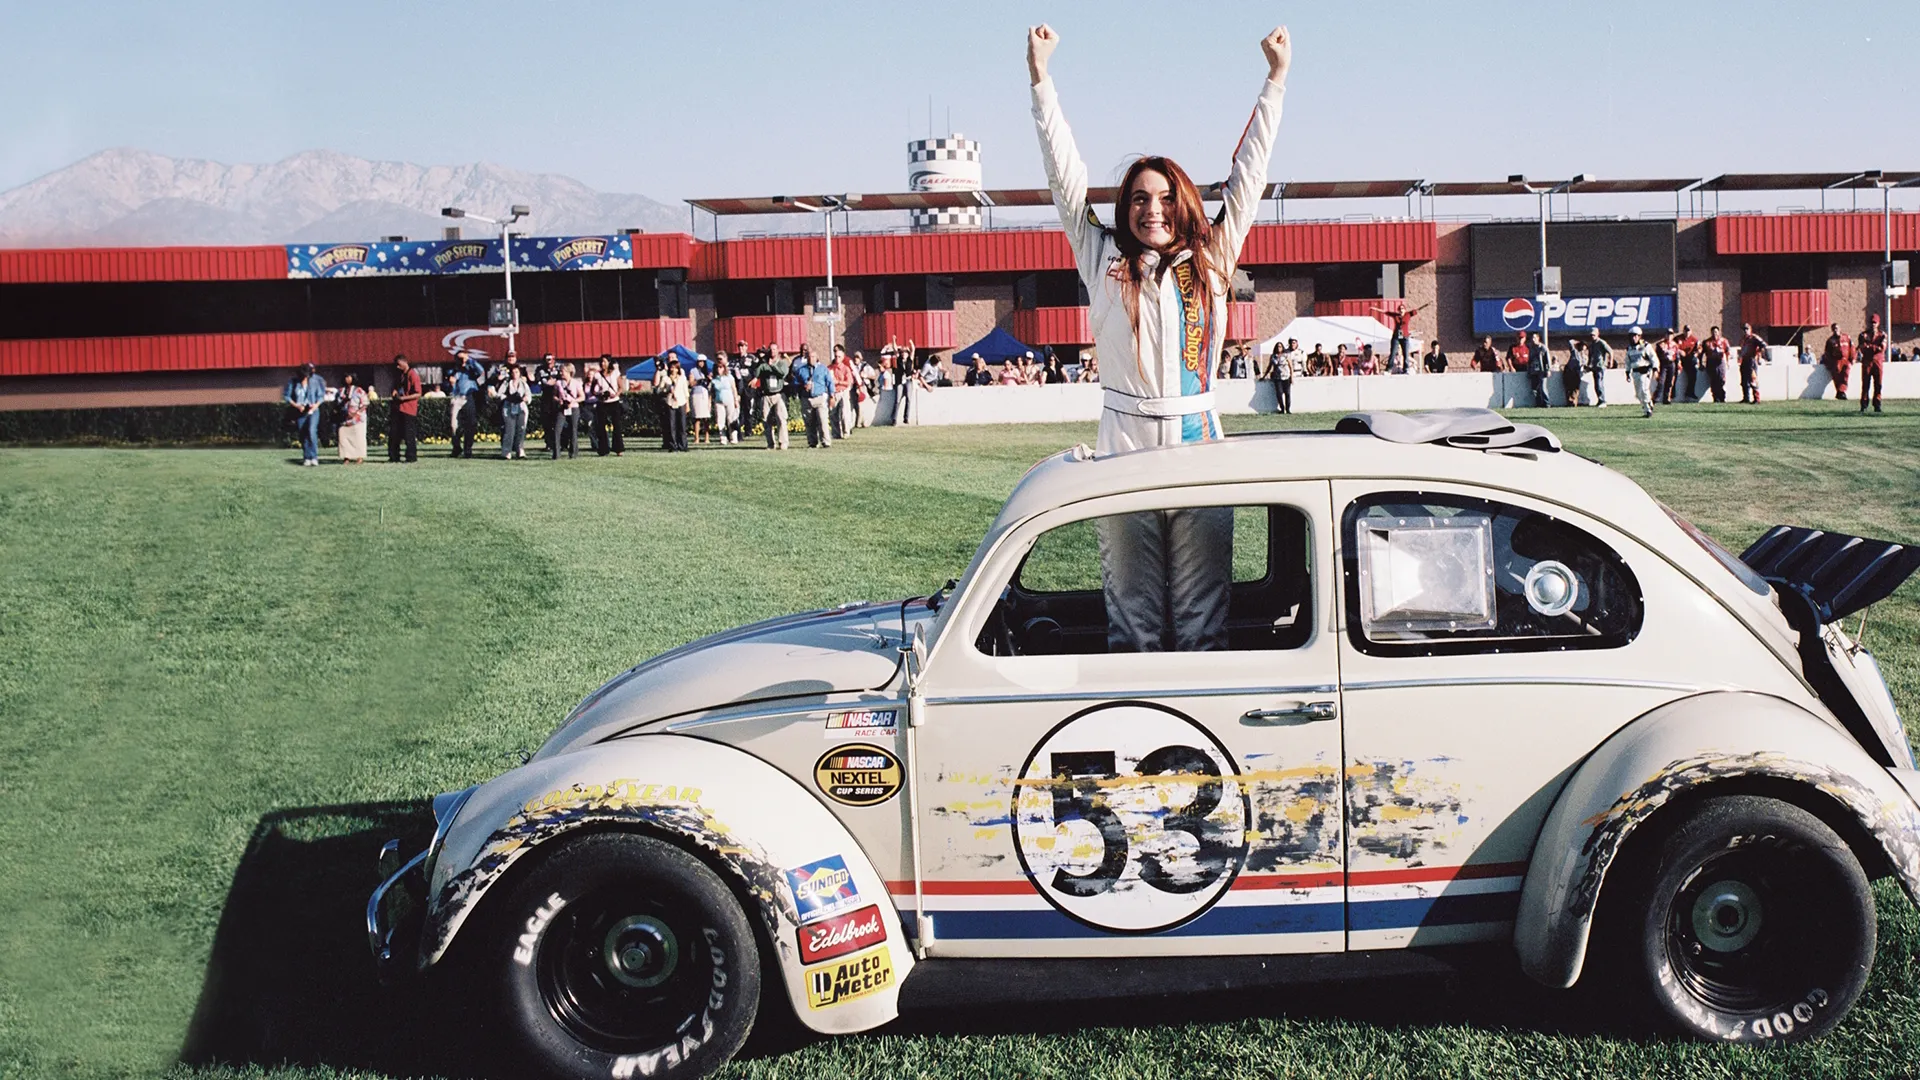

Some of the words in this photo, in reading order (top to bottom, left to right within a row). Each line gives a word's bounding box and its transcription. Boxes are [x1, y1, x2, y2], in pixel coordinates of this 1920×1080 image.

[1539, 296, 1650, 328] PEPSI
[1183, 325, 1203, 372] Shops
[847, 711, 892, 728] NASCAR
[854, 729, 877, 737] RACE
[880, 728, 897, 736] CAR
[847, 756, 885, 769] NASCAR
[830, 771, 888, 785] NEXTEL
[836, 786, 854, 795] CUP
[855, 786, 884, 795] SERIES
[1050, 745, 1228, 898] 53
[799, 870, 848, 898] SUNOCO
[513, 891, 567, 966] EAGLE
[809, 914, 880, 953] Edelbrock
[835, 955, 880, 982] Auto
[833, 967, 890, 1003] Meter
